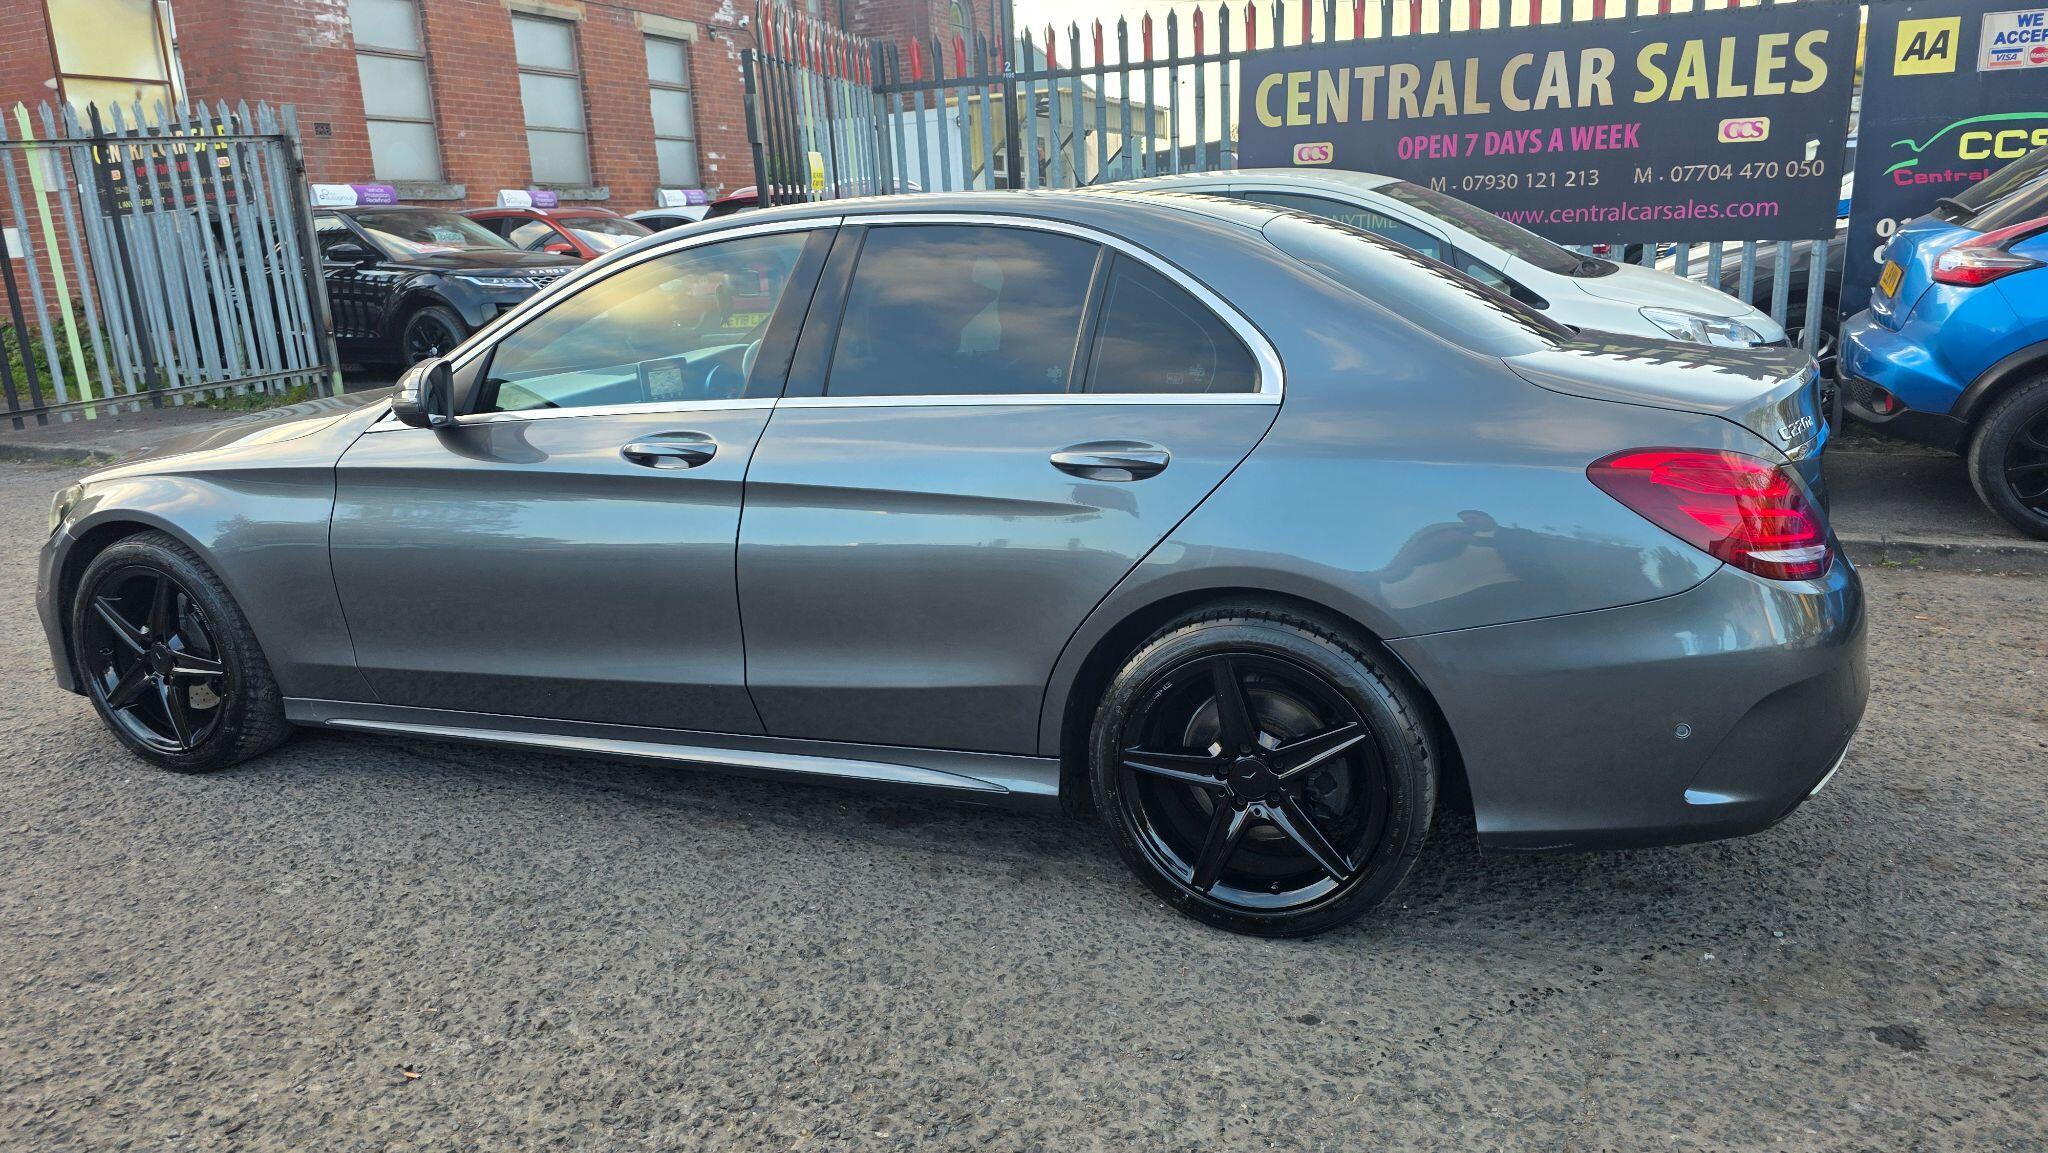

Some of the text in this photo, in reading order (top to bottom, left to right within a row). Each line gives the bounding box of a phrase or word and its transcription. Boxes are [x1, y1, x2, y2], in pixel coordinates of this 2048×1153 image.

[2017, 13, 2045, 28] WE
[1901, 29, 1950, 62] AA
[1996, 53, 2018, 61] VISA
[1255, 29, 1830, 128] CENTRAL CAR SALES
[1397, 122, 1641, 160] OPEN 7 DAYS A WEEK
[1462, 173, 1519, 191] 07930
[1526, 172, 1556, 188] 121
[1564, 169, 1600, 187] 213
[1670, 164, 1733, 183] 07704
[1739, 161, 1779, 180] 470
[1785, 159, 1825, 178] 050
[1893, 169, 1990, 186] Central
